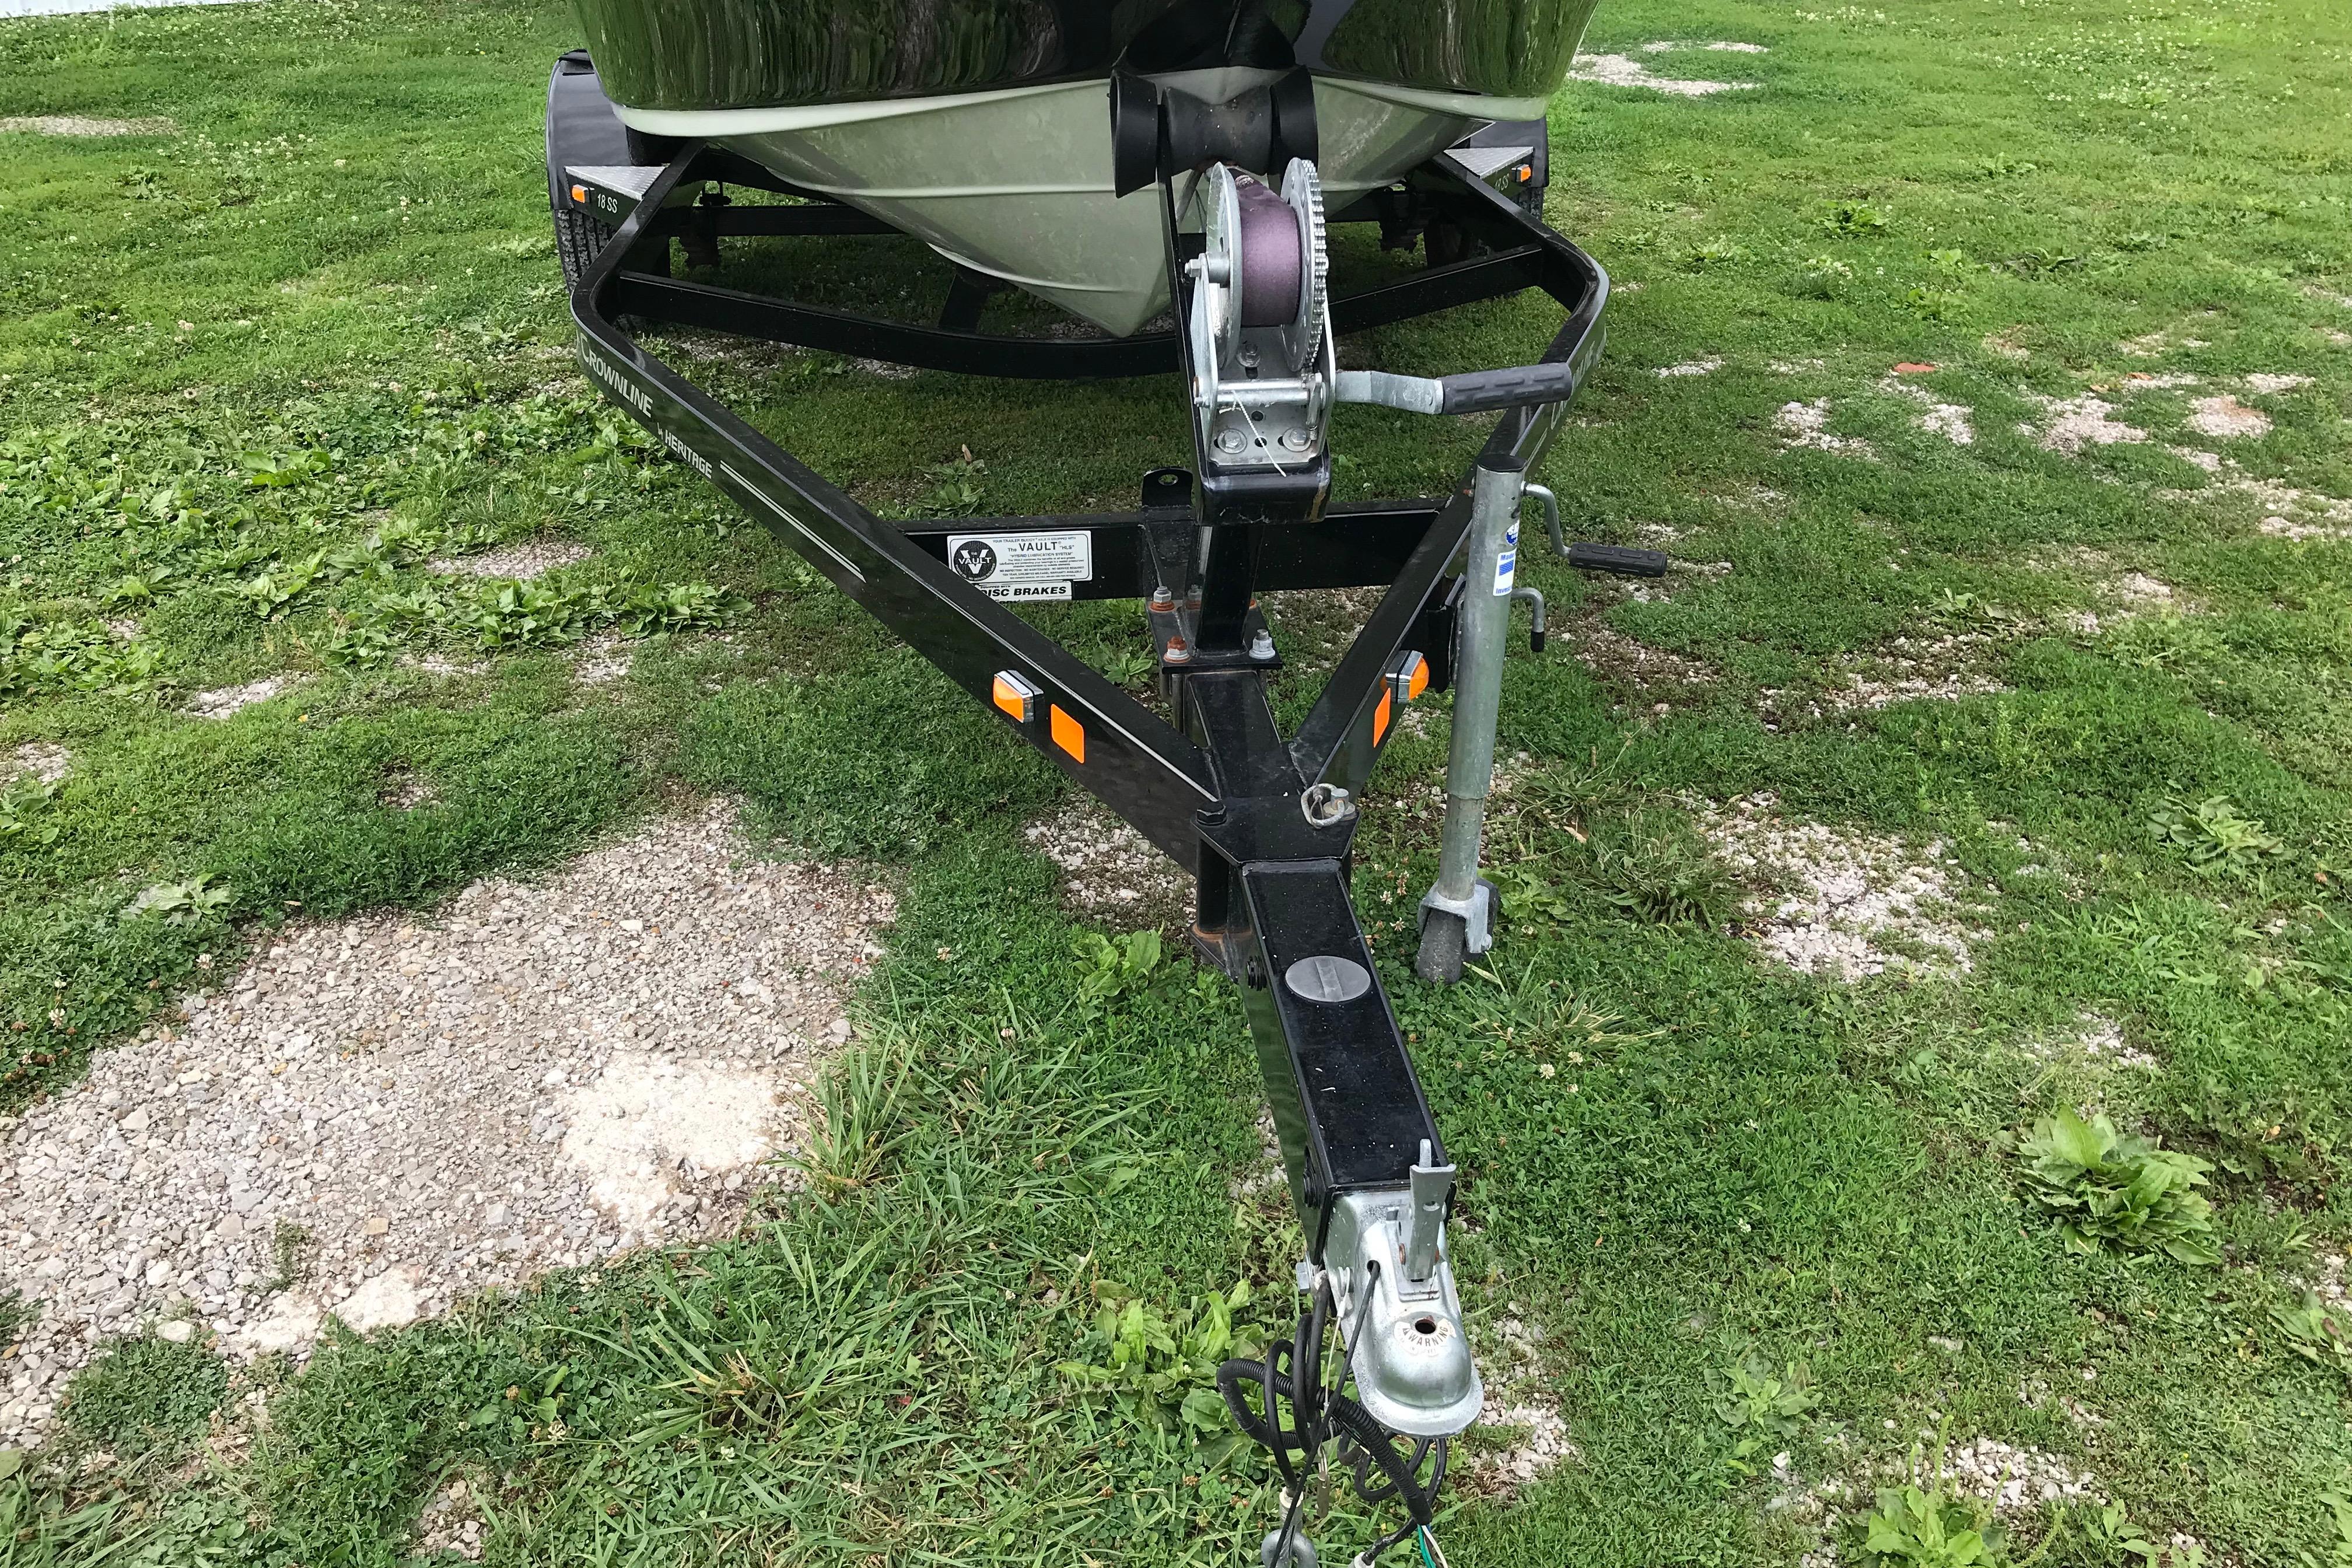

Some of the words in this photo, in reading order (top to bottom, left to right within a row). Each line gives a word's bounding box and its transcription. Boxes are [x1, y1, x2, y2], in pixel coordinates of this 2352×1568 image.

[597, 193, 606, 209] 18
[607, 196, 618, 214] SS
[579, 332, 653, 418] CROWNLINE
[665, 429, 712, 479] HERITAGE
[1013, 586, 1066, 596] BRAKES
[1408, 1326, 1448, 1347] WARNING
